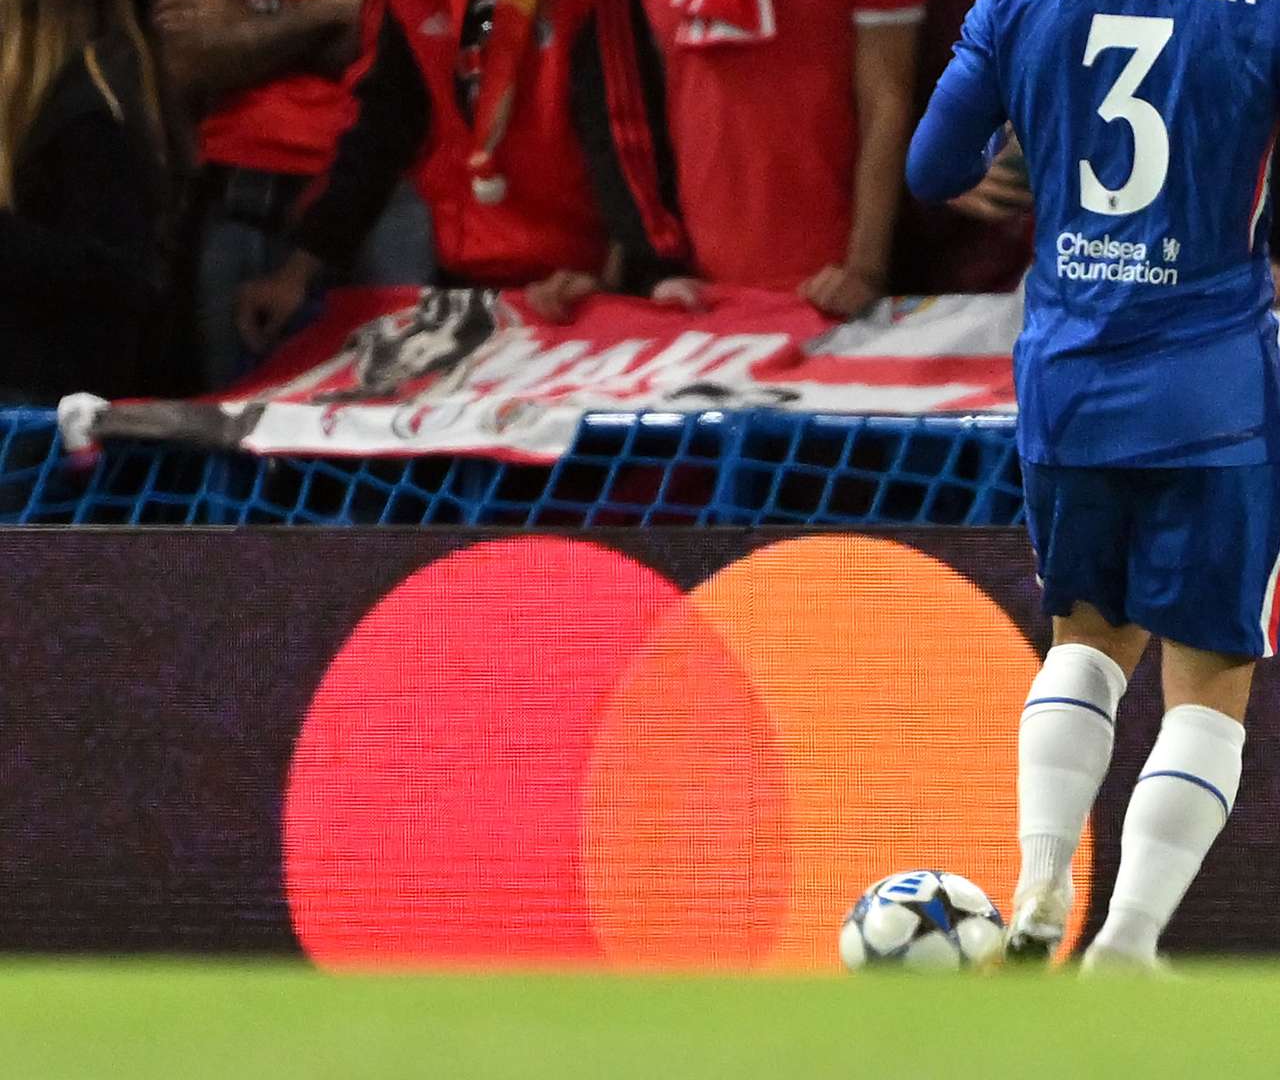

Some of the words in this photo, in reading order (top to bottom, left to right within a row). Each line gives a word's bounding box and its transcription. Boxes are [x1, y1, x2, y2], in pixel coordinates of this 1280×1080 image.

[1079, 13, 1174, 215] 3
[1056, 232, 1147, 261] Chelsea
[1056, 257, 1178, 285] Foundation
